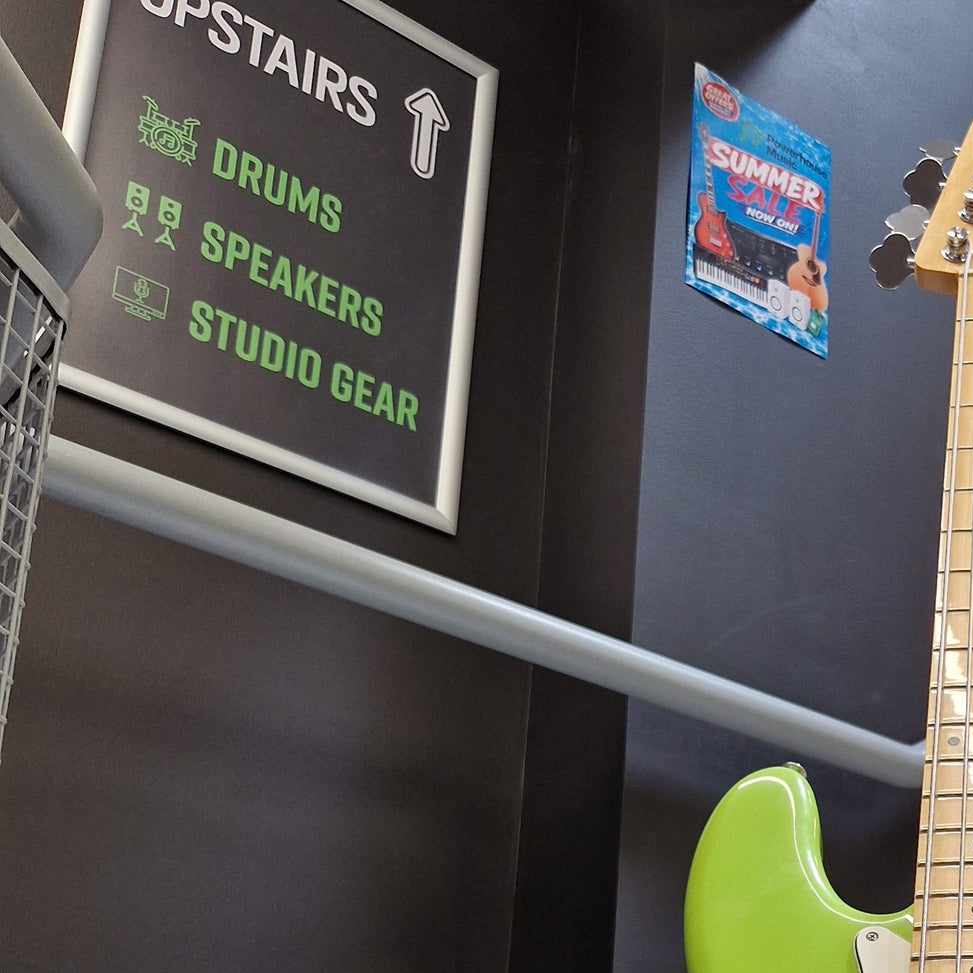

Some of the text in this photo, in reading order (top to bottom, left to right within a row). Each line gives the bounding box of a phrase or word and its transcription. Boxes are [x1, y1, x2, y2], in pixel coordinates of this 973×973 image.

[212, 138, 343, 233] DRUMS
[710, 141, 822, 211] SUMMER
[766, 134, 829, 179] Powerhouse
[766, 146, 799, 170] Music
[727, 173, 801, 223] SALE
[745, 206, 800, 234] NOW ON!
[200, 221, 384, 338] SPEAKERS
[188, 300, 420, 431] STUDIO GEAR
